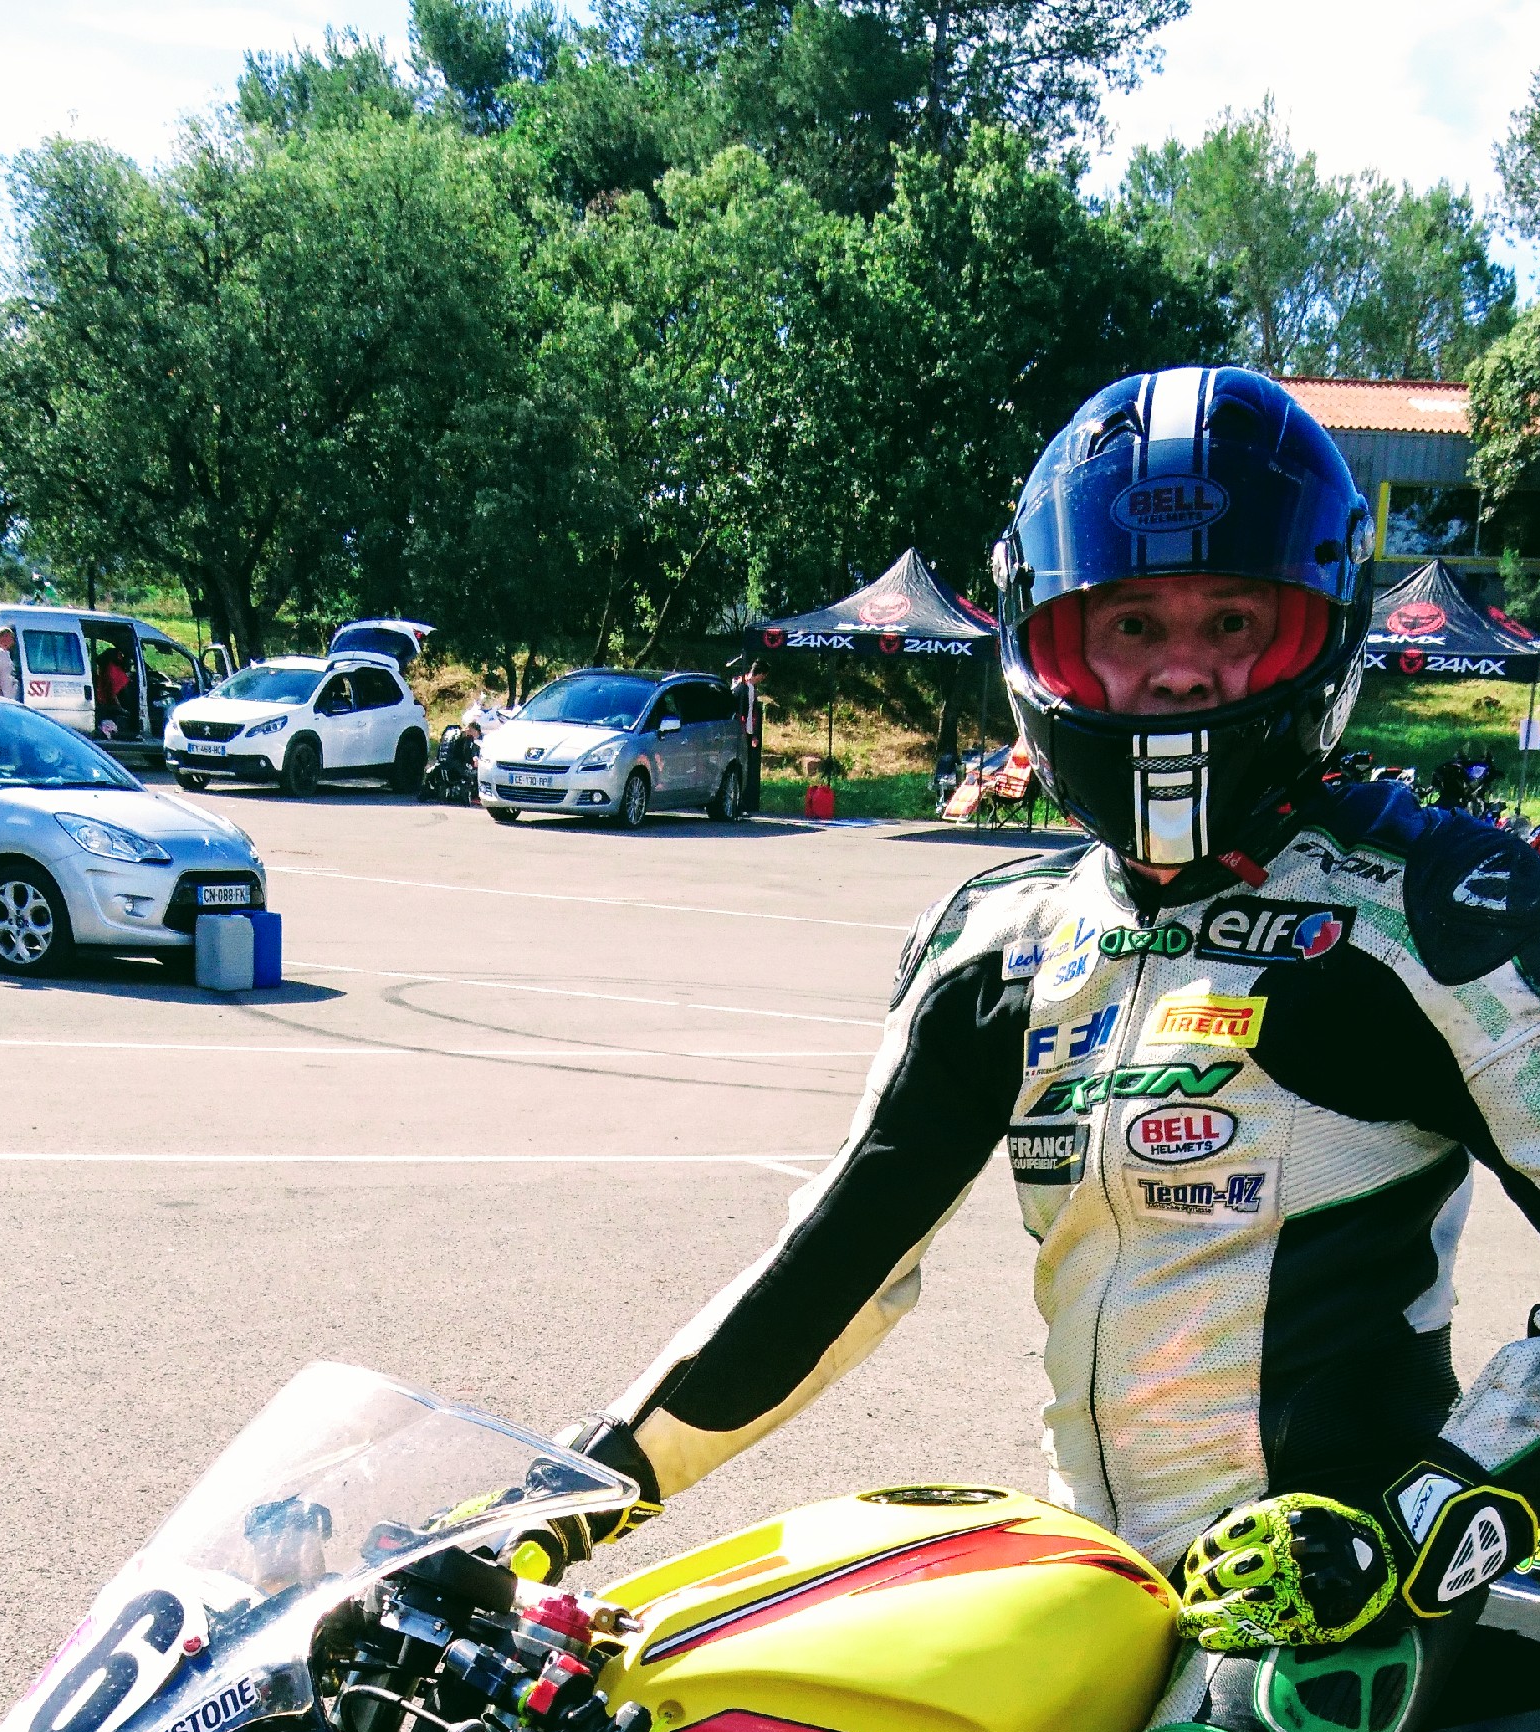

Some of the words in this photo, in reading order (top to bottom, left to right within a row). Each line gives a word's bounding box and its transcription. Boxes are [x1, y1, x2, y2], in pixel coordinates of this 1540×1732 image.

[1129, 485, 1213, 515] BELL
[1138, 511, 1203, 525] HELMETS
[787, 630, 854, 650] 24MX
[903, 638, 972, 656] 24MX
[1425, 656, 1505, 676] 24MX
[1208, 910, 1298, 952] elf
[1156, 1006, 1254, 1037] PIRELLI
[1141, 1114, 1220, 1144] BELL
[1009, 1134, 1075, 1158] FRANCE
[1151, 1140, 1213, 1156] HELMETS
